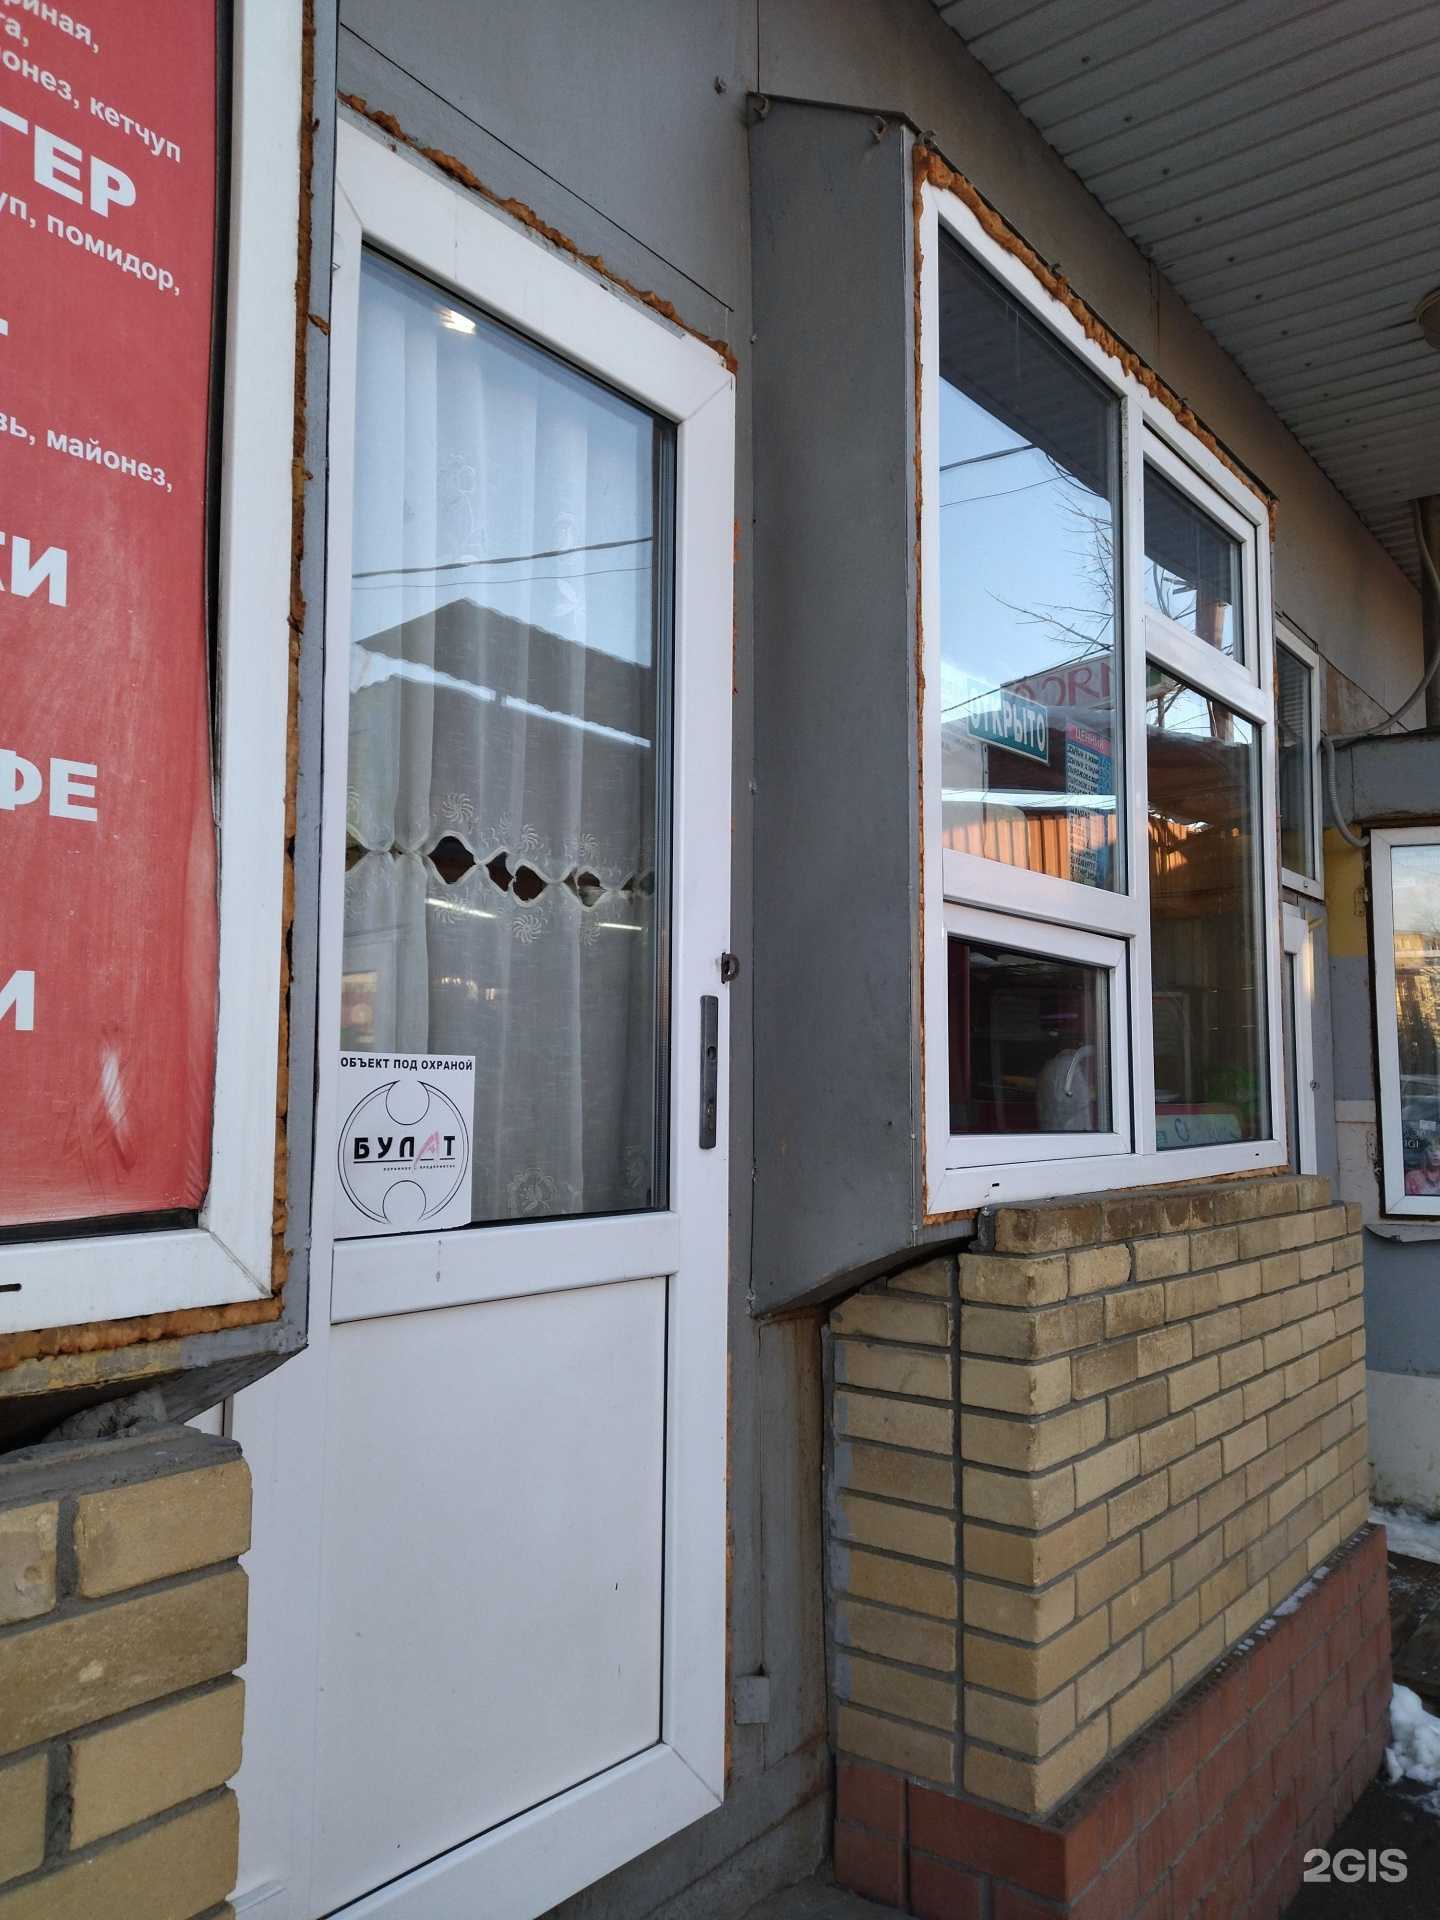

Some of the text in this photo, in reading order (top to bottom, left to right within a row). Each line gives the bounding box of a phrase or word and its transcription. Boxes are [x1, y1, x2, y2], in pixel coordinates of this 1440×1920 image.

[0, 12, 29, 47] а,
[0, 48, 181, 163] онез, кетчуп
[47, 214, 180, 297] помидор,
[47, 429, 173, 492] майонез,
[0, 531, 68, 608] И
[970, 688, 1046, 752] ОТКРЫТО
[340, 1057, 473, 1071] ОБЪЕКТ ПОД ОХРАНОЙ
[353, 1131, 456, 1163] БУЛАТ
